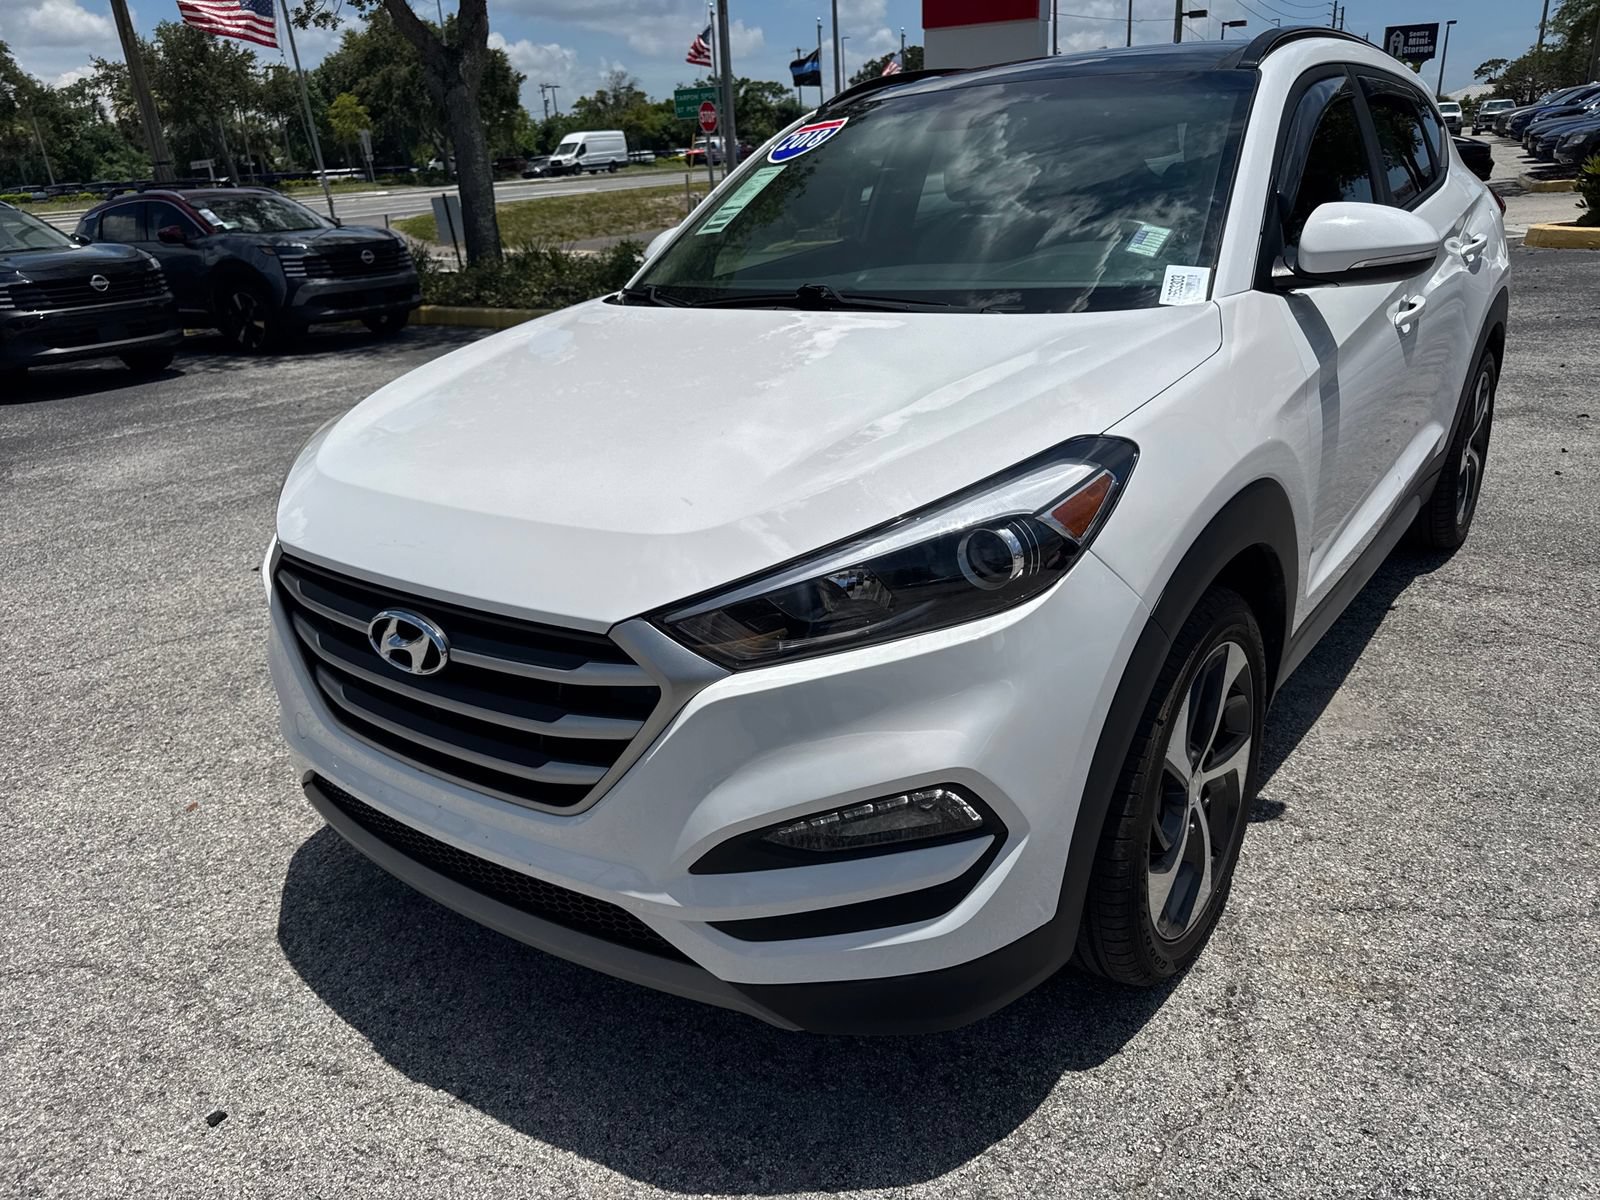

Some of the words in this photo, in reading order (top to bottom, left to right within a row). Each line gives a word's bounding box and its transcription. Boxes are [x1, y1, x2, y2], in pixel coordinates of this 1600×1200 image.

[1408, 37, 1431, 45] Mini-
[1403, 46, 1434, 54] Storage
[700, 111, 716, 123] STOP
[776, 129, 831, 152] 2018
